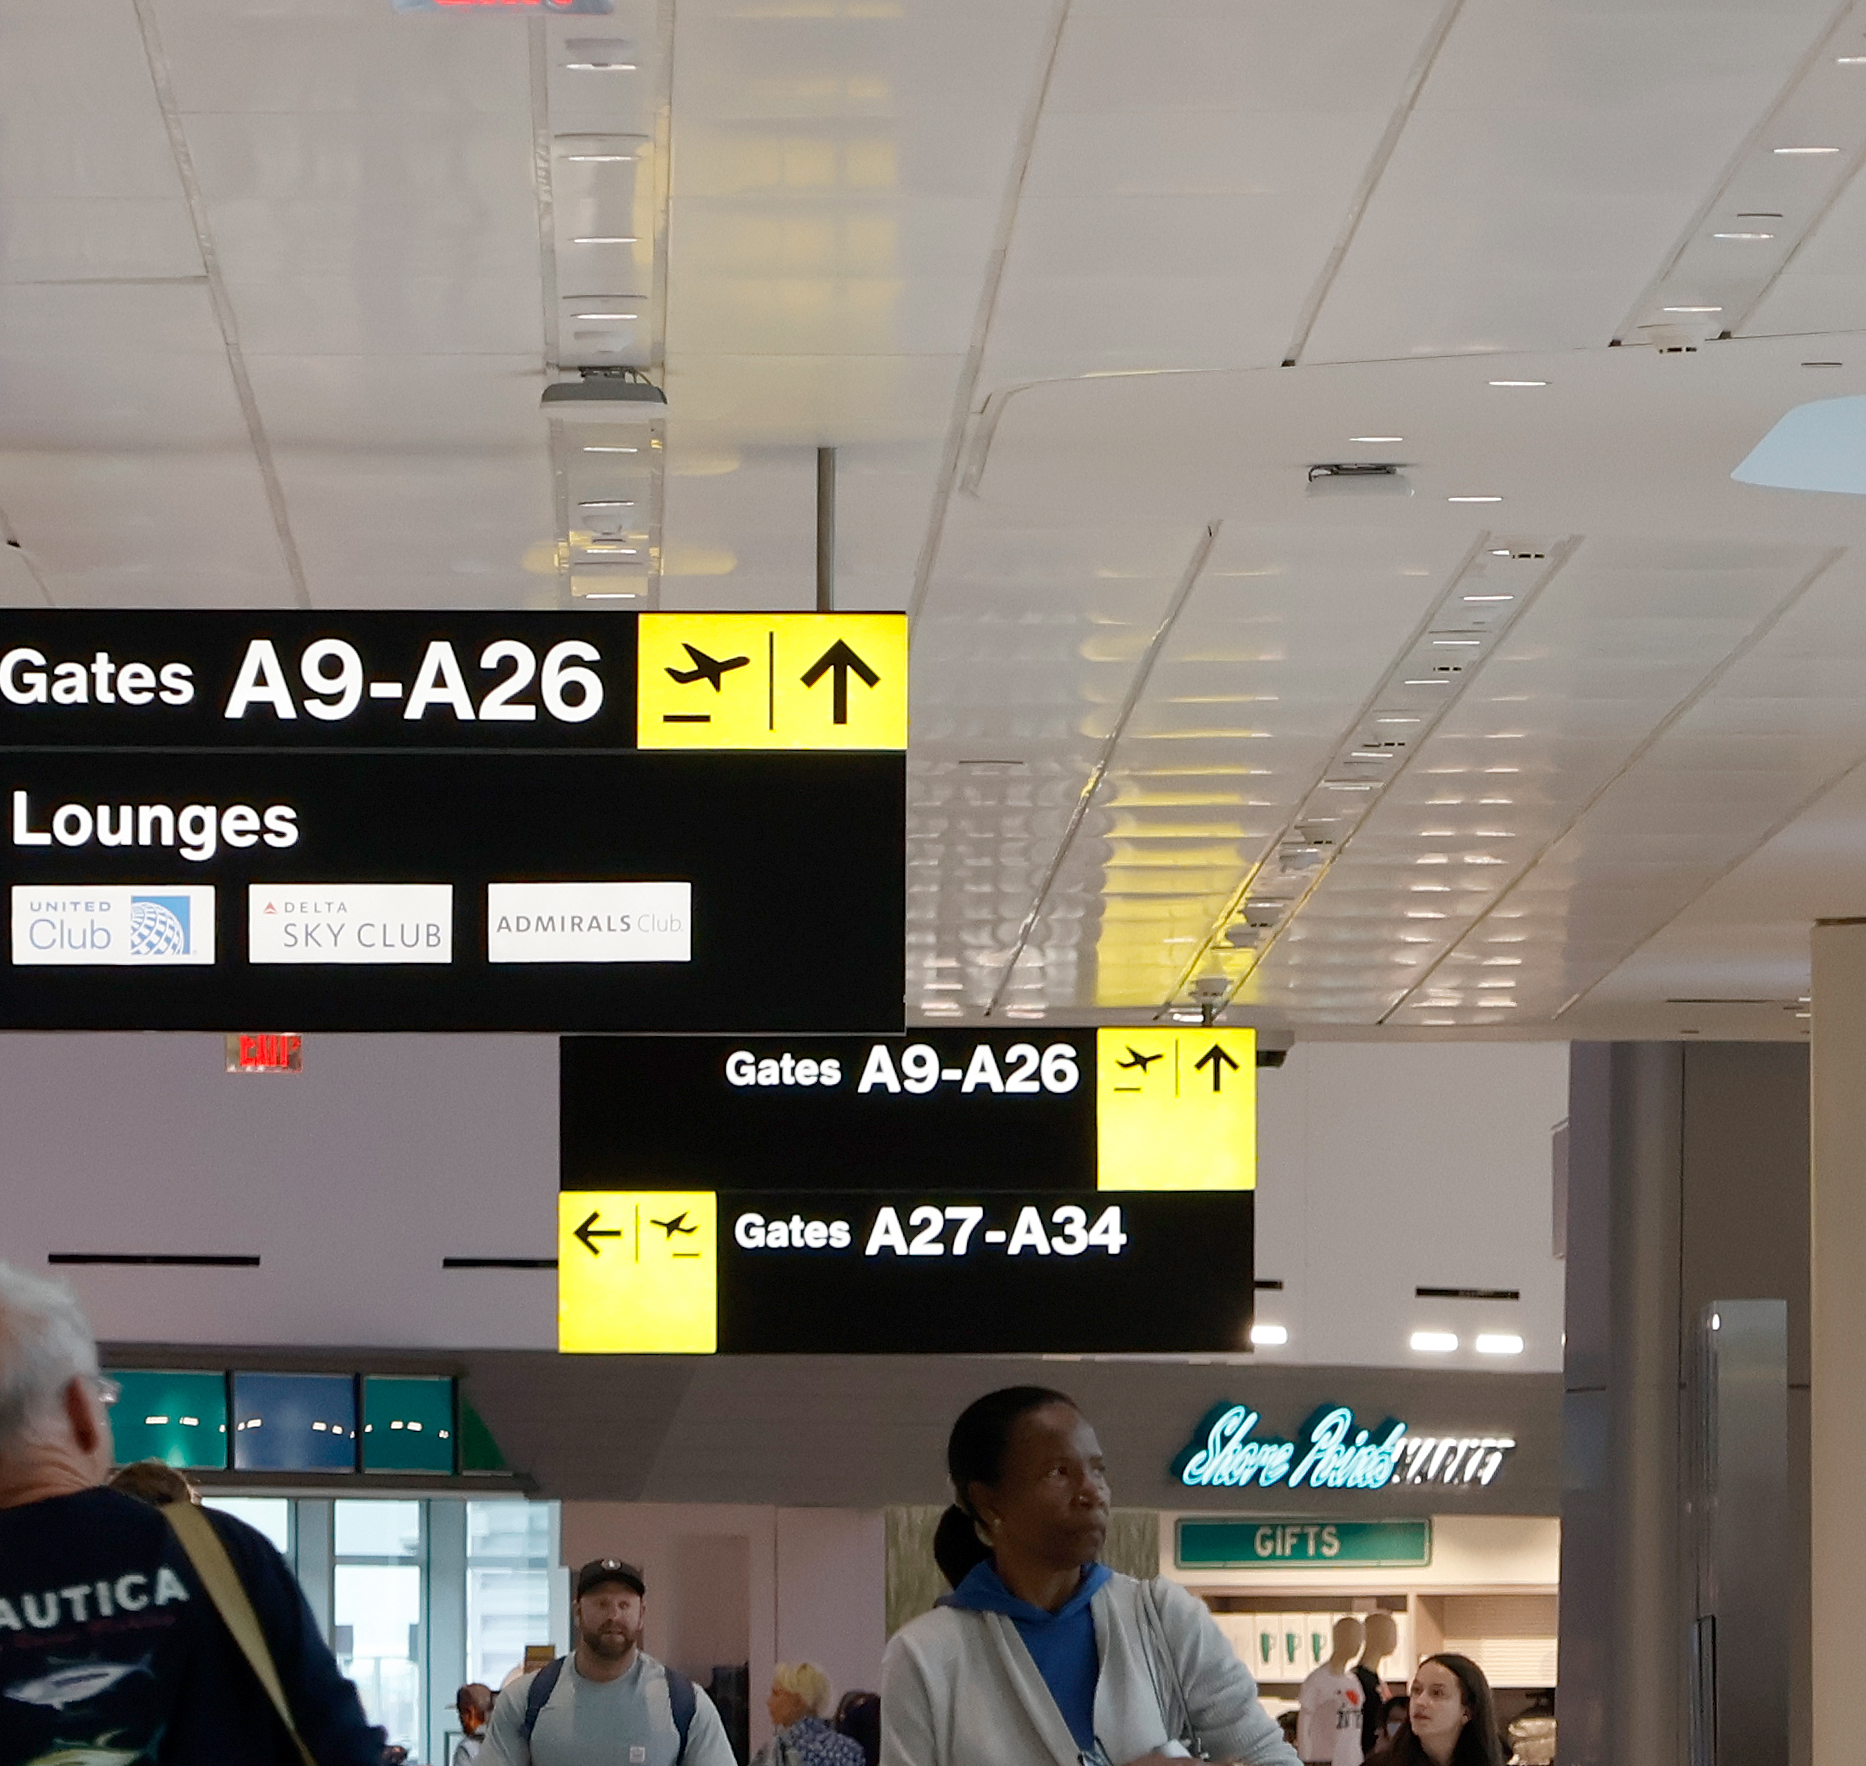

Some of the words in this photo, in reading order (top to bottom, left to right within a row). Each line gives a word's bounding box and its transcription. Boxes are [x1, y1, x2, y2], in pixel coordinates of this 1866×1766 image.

[224, 638, 604, 723] A9-A26
[13, 790, 299, 862] Lounges
[29, 900, 112, 913] UNITED
[284, 901, 348, 914] DELTA
[29, 918, 111, 950] Club
[283, 922, 346, 948] SKY
[357, 922, 441, 949] CLUB
[496, 914, 631, 933] ADMIRALS
[725, 1050, 842, 1086] Gates
[857, 1043, 1080, 1094] A9-A26
[734, 1212, 852, 1249] Gates
[864, 1205, 1128, 1256] A27-A34
[1254, 1525, 1340, 1558] GIFTS
